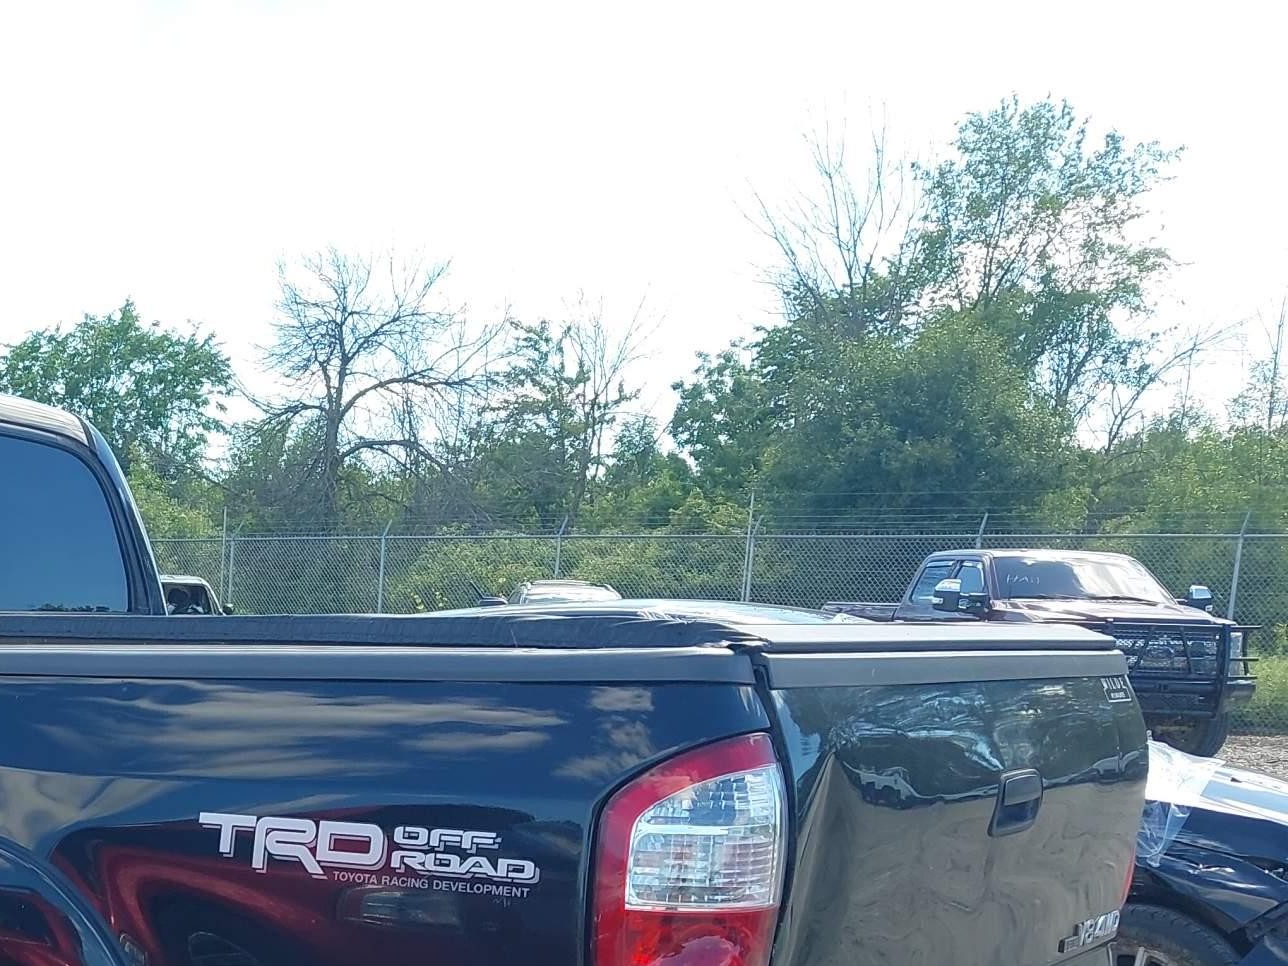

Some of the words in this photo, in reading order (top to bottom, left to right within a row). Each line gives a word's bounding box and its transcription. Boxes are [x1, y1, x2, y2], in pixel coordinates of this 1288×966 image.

[198, 811, 389, 880] TRD
[392, 825, 502, 851] OFF
[390, 850, 540, 885] ROAD
[332, 870, 379, 886] TOYOTA
[381, 874, 429, 890] RACING
[432, 878, 531, 899] DEVELOPMENT
